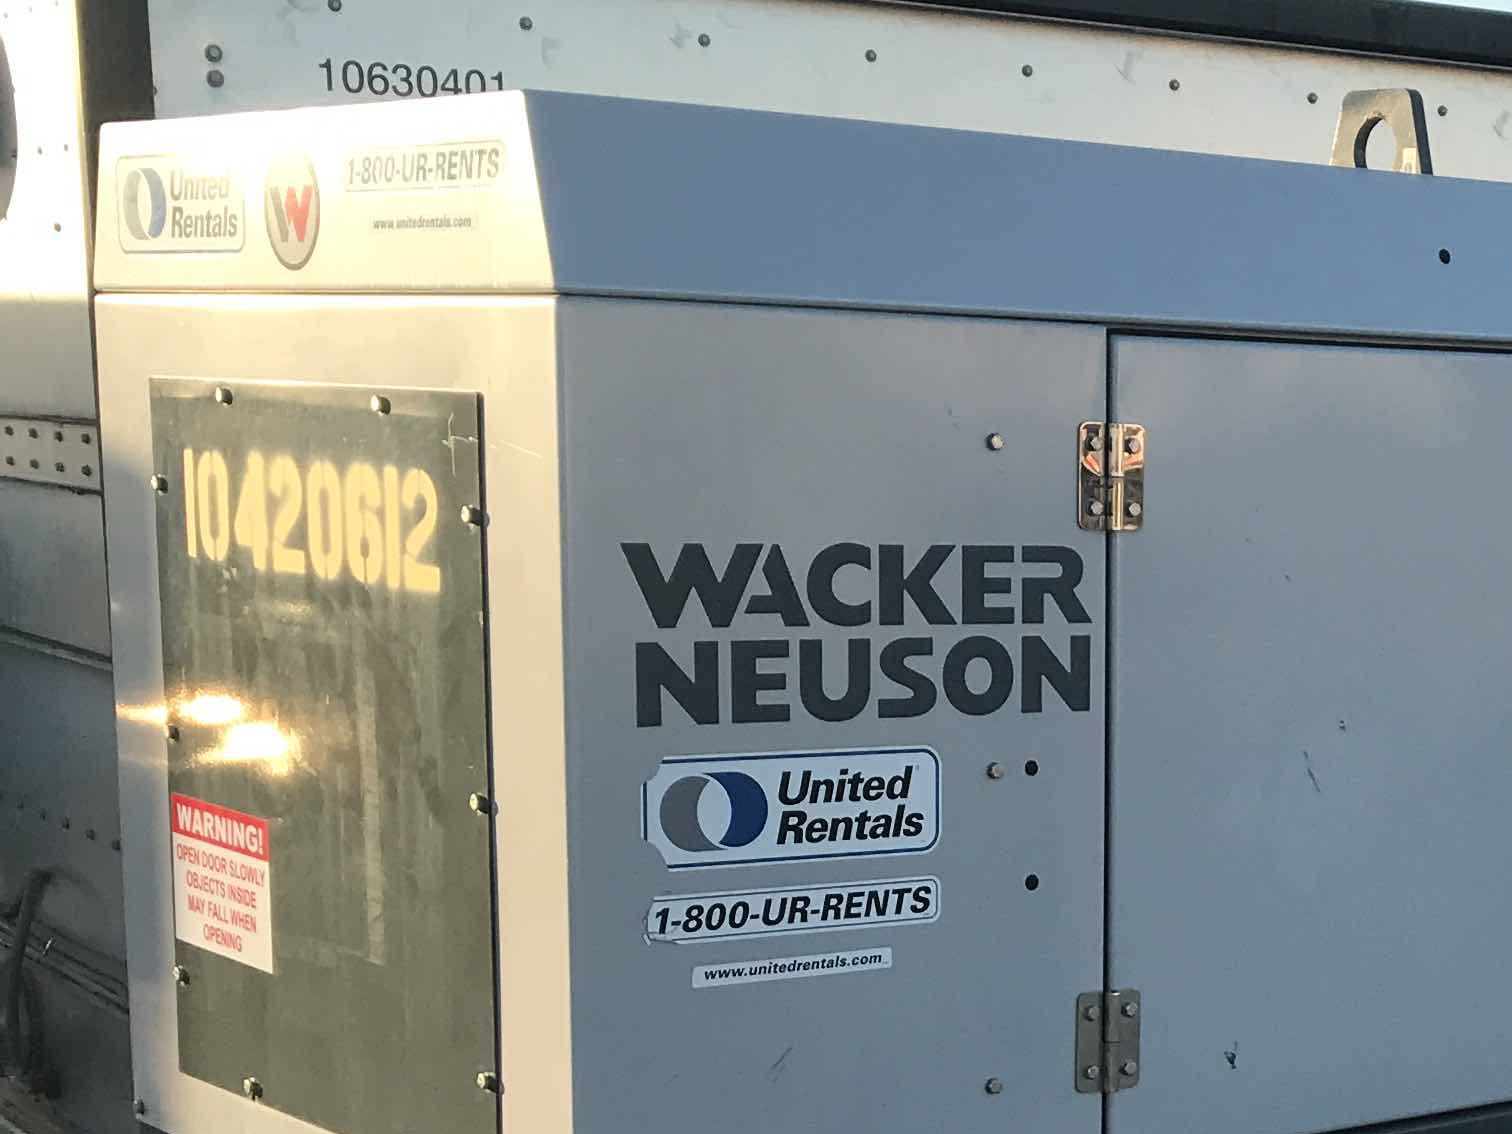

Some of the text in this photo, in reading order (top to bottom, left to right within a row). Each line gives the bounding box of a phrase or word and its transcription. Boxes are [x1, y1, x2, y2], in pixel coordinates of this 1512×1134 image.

[318, 57, 504, 98] 10630401
[170, 168, 230, 201] United
[347, 147, 500, 185] 1-800-UR-RENTS
[170, 204, 238, 239] Rentals
[183, 447, 441, 592] 10420612
[620, 542, 1093, 628] WACKER
[635, 634, 1091, 727] NEUSON
[777, 765, 914, 806] United
[176, 803, 264, 855] WARNING!
[776, 804, 924, 845] Rentals
[176, 843, 265, 888] OPEN DOOR SLOWLY
[186, 870, 256, 909] OBJECTS INSIDE
[187, 894, 257, 934] MAY FALL WHEN
[654, 886, 932, 935] 1-800-UR-RENTS
[203, 924, 242, 952] OPENING
[703, 952, 883, 981] www.unitedrentals.com
